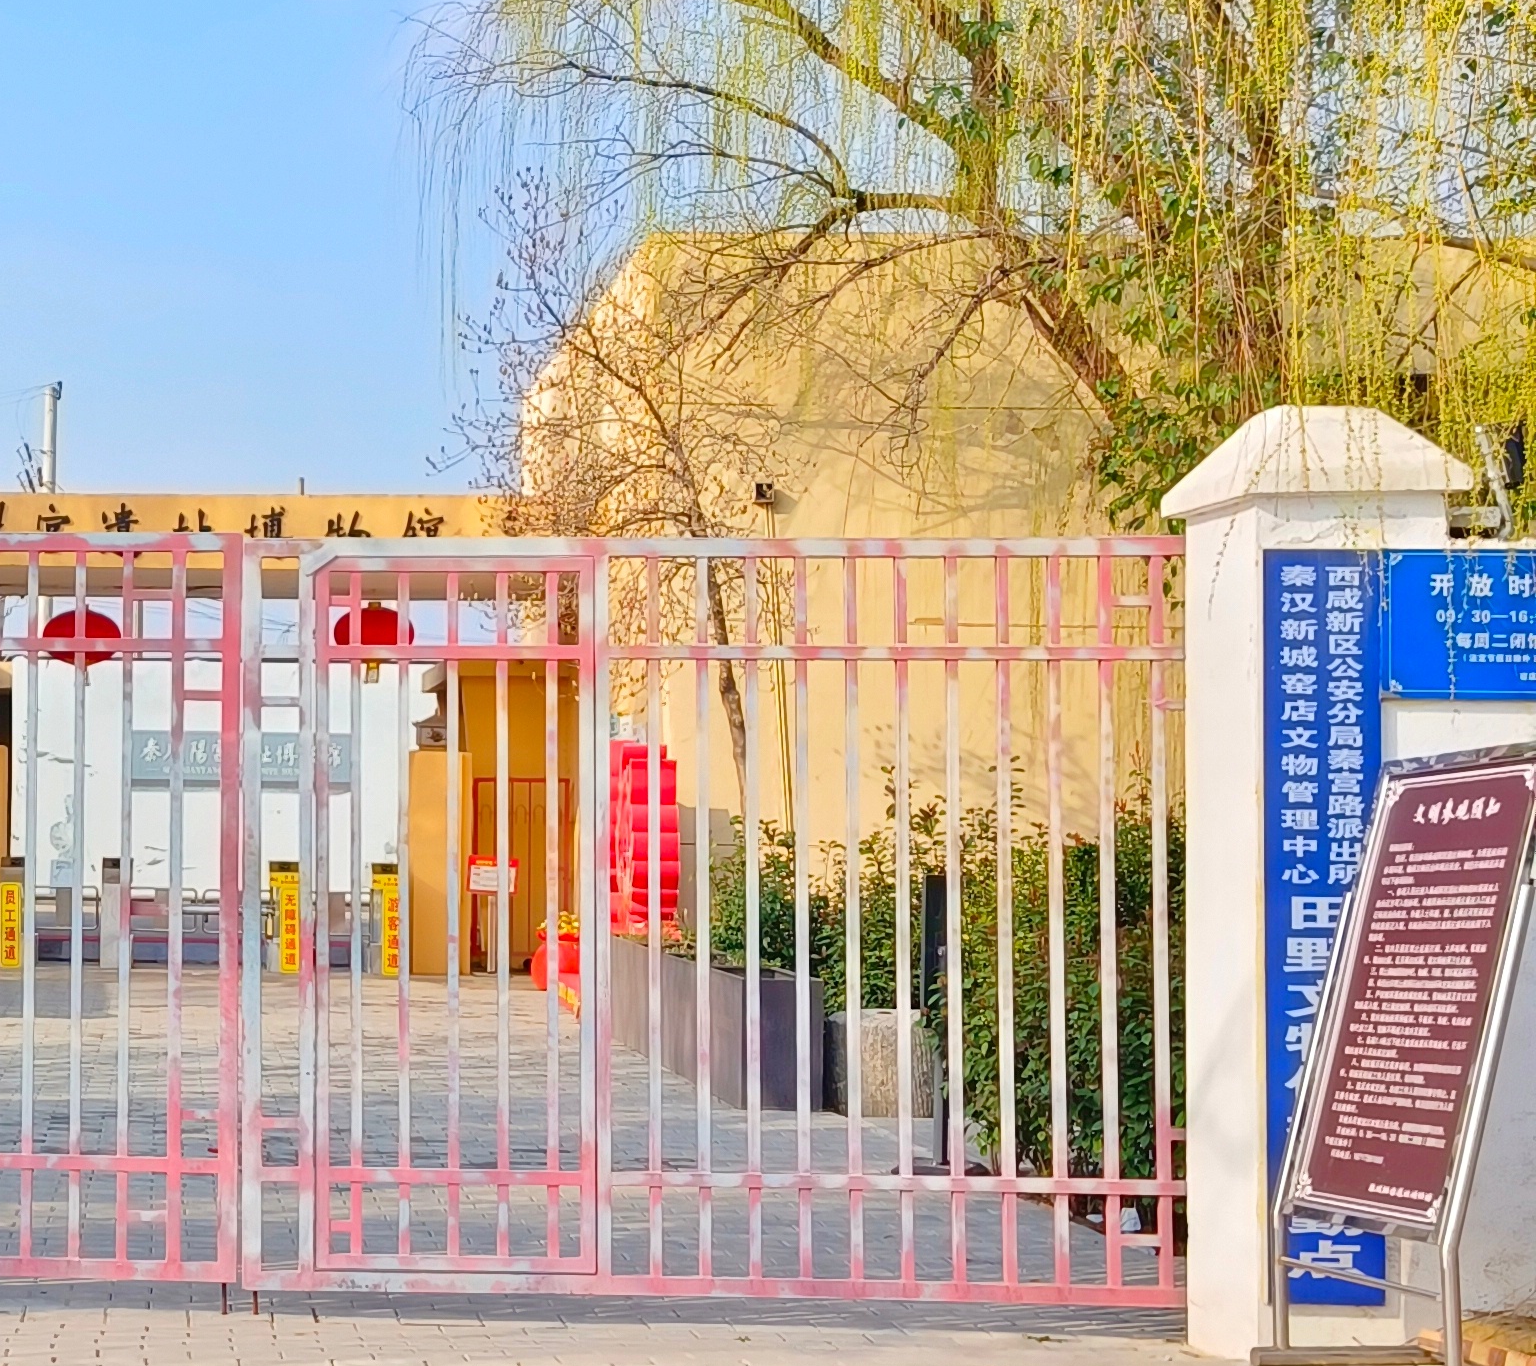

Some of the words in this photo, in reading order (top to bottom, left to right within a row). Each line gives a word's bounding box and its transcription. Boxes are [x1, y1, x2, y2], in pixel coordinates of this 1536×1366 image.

[1279, 564, 1320, 885] 秦汉新城窑店文物管理中心
[1324, 565, 1365, 885] 西咸新区公安分局秦宫路派出所
[4, 889, 17, 960] 员工通道
